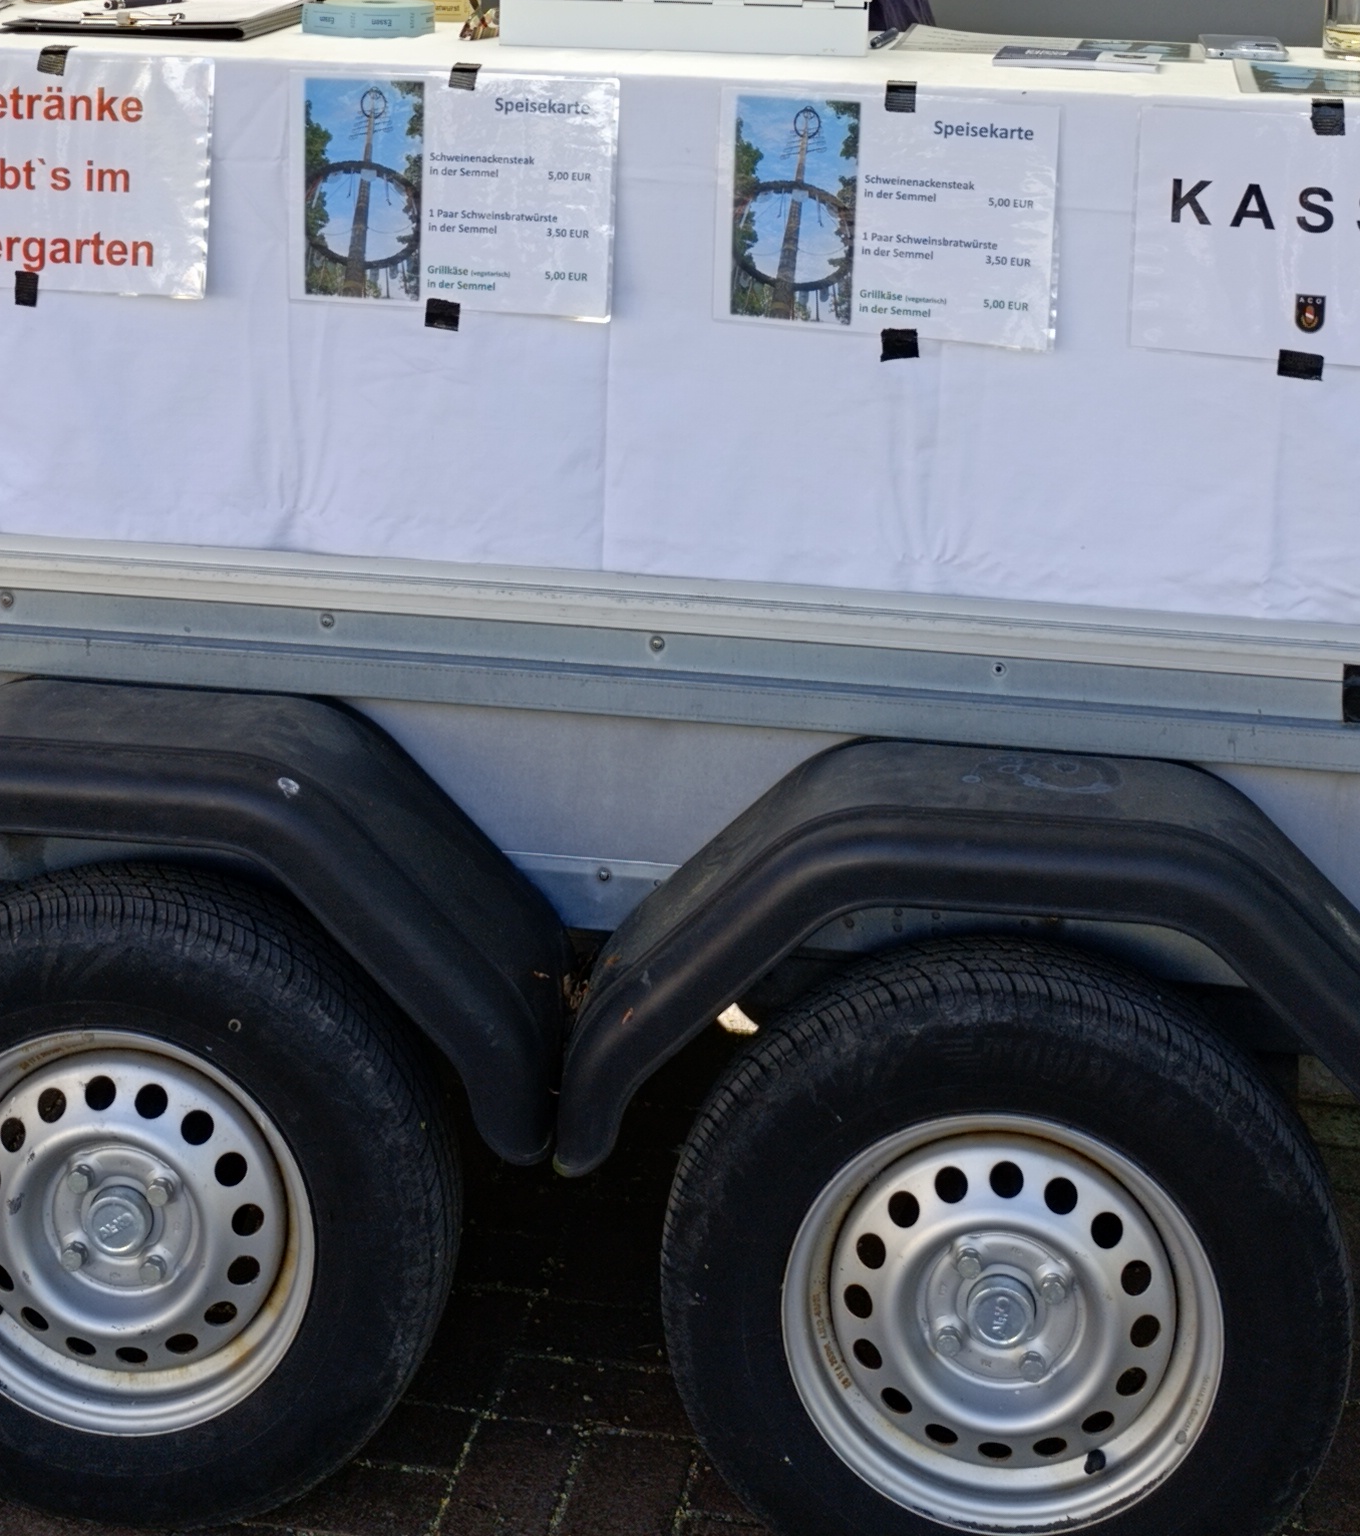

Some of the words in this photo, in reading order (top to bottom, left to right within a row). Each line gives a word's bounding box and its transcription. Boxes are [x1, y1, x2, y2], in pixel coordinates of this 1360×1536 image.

[372, 19, 392, 27] Essen
[495, 97, 590, 115] Speisekarte
[934, 120, 1034, 140] Speisekarte
[430, 153, 534, 165] Schweinenackensteak
[87, 160, 130, 192] im
[430, 167, 438, 176] in
[441, 167, 457, 176] der
[460, 168, 498, 178] Semmel
[548, 172, 569, 182] 5,00
[571, 173, 590, 182] EUR
[865, 175, 974, 190] Schweinenackensteak
[864, 189, 873, 198] in
[877, 190, 893, 200] der
[896, 192, 936, 202] Semmel
[988, 198, 1011, 208] 5,00
[1013, 199, 1034, 209] EUR
[437, 210, 459, 219] Paar
[461, 210, 558, 223] Schweinsbratwürste
[428, 223, 437, 232] in
[440, 224, 456, 233] der
[459, 225, 497, 234] Semmel
[546, 228, 567, 239] 3,50
[569, 229, 589, 238] EUR
[863, 232, 867, 240] 1
[872, 233, 894, 243] Paar
[896, 234, 998, 251] Schweinsbratwürste
[862, 247, 870, 256] in
[874, 247, 891, 257] der
[893, 249, 933, 260] Semmel
[985, 255, 1008, 266] 3,50
[1010, 257, 1031, 267] EUR
[427, 265, 468, 276] Grillkäse
[545, 271, 565, 281] 5,00
[567, 272, 587, 281] EUR
[427, 280, 436, 288] in
[439, 280, 454, 289] der
[457, 281, 495, 291] Semmel
[859, 290, 902, 302] Grillkäse
[983, 299, 1006, 310] 5,00
[1008, 301, 1028, 311] EUR
[859, 304, 868, 313] in
[871, 304, 888, 315] der
[890, 307, 931, 318] Semmel
